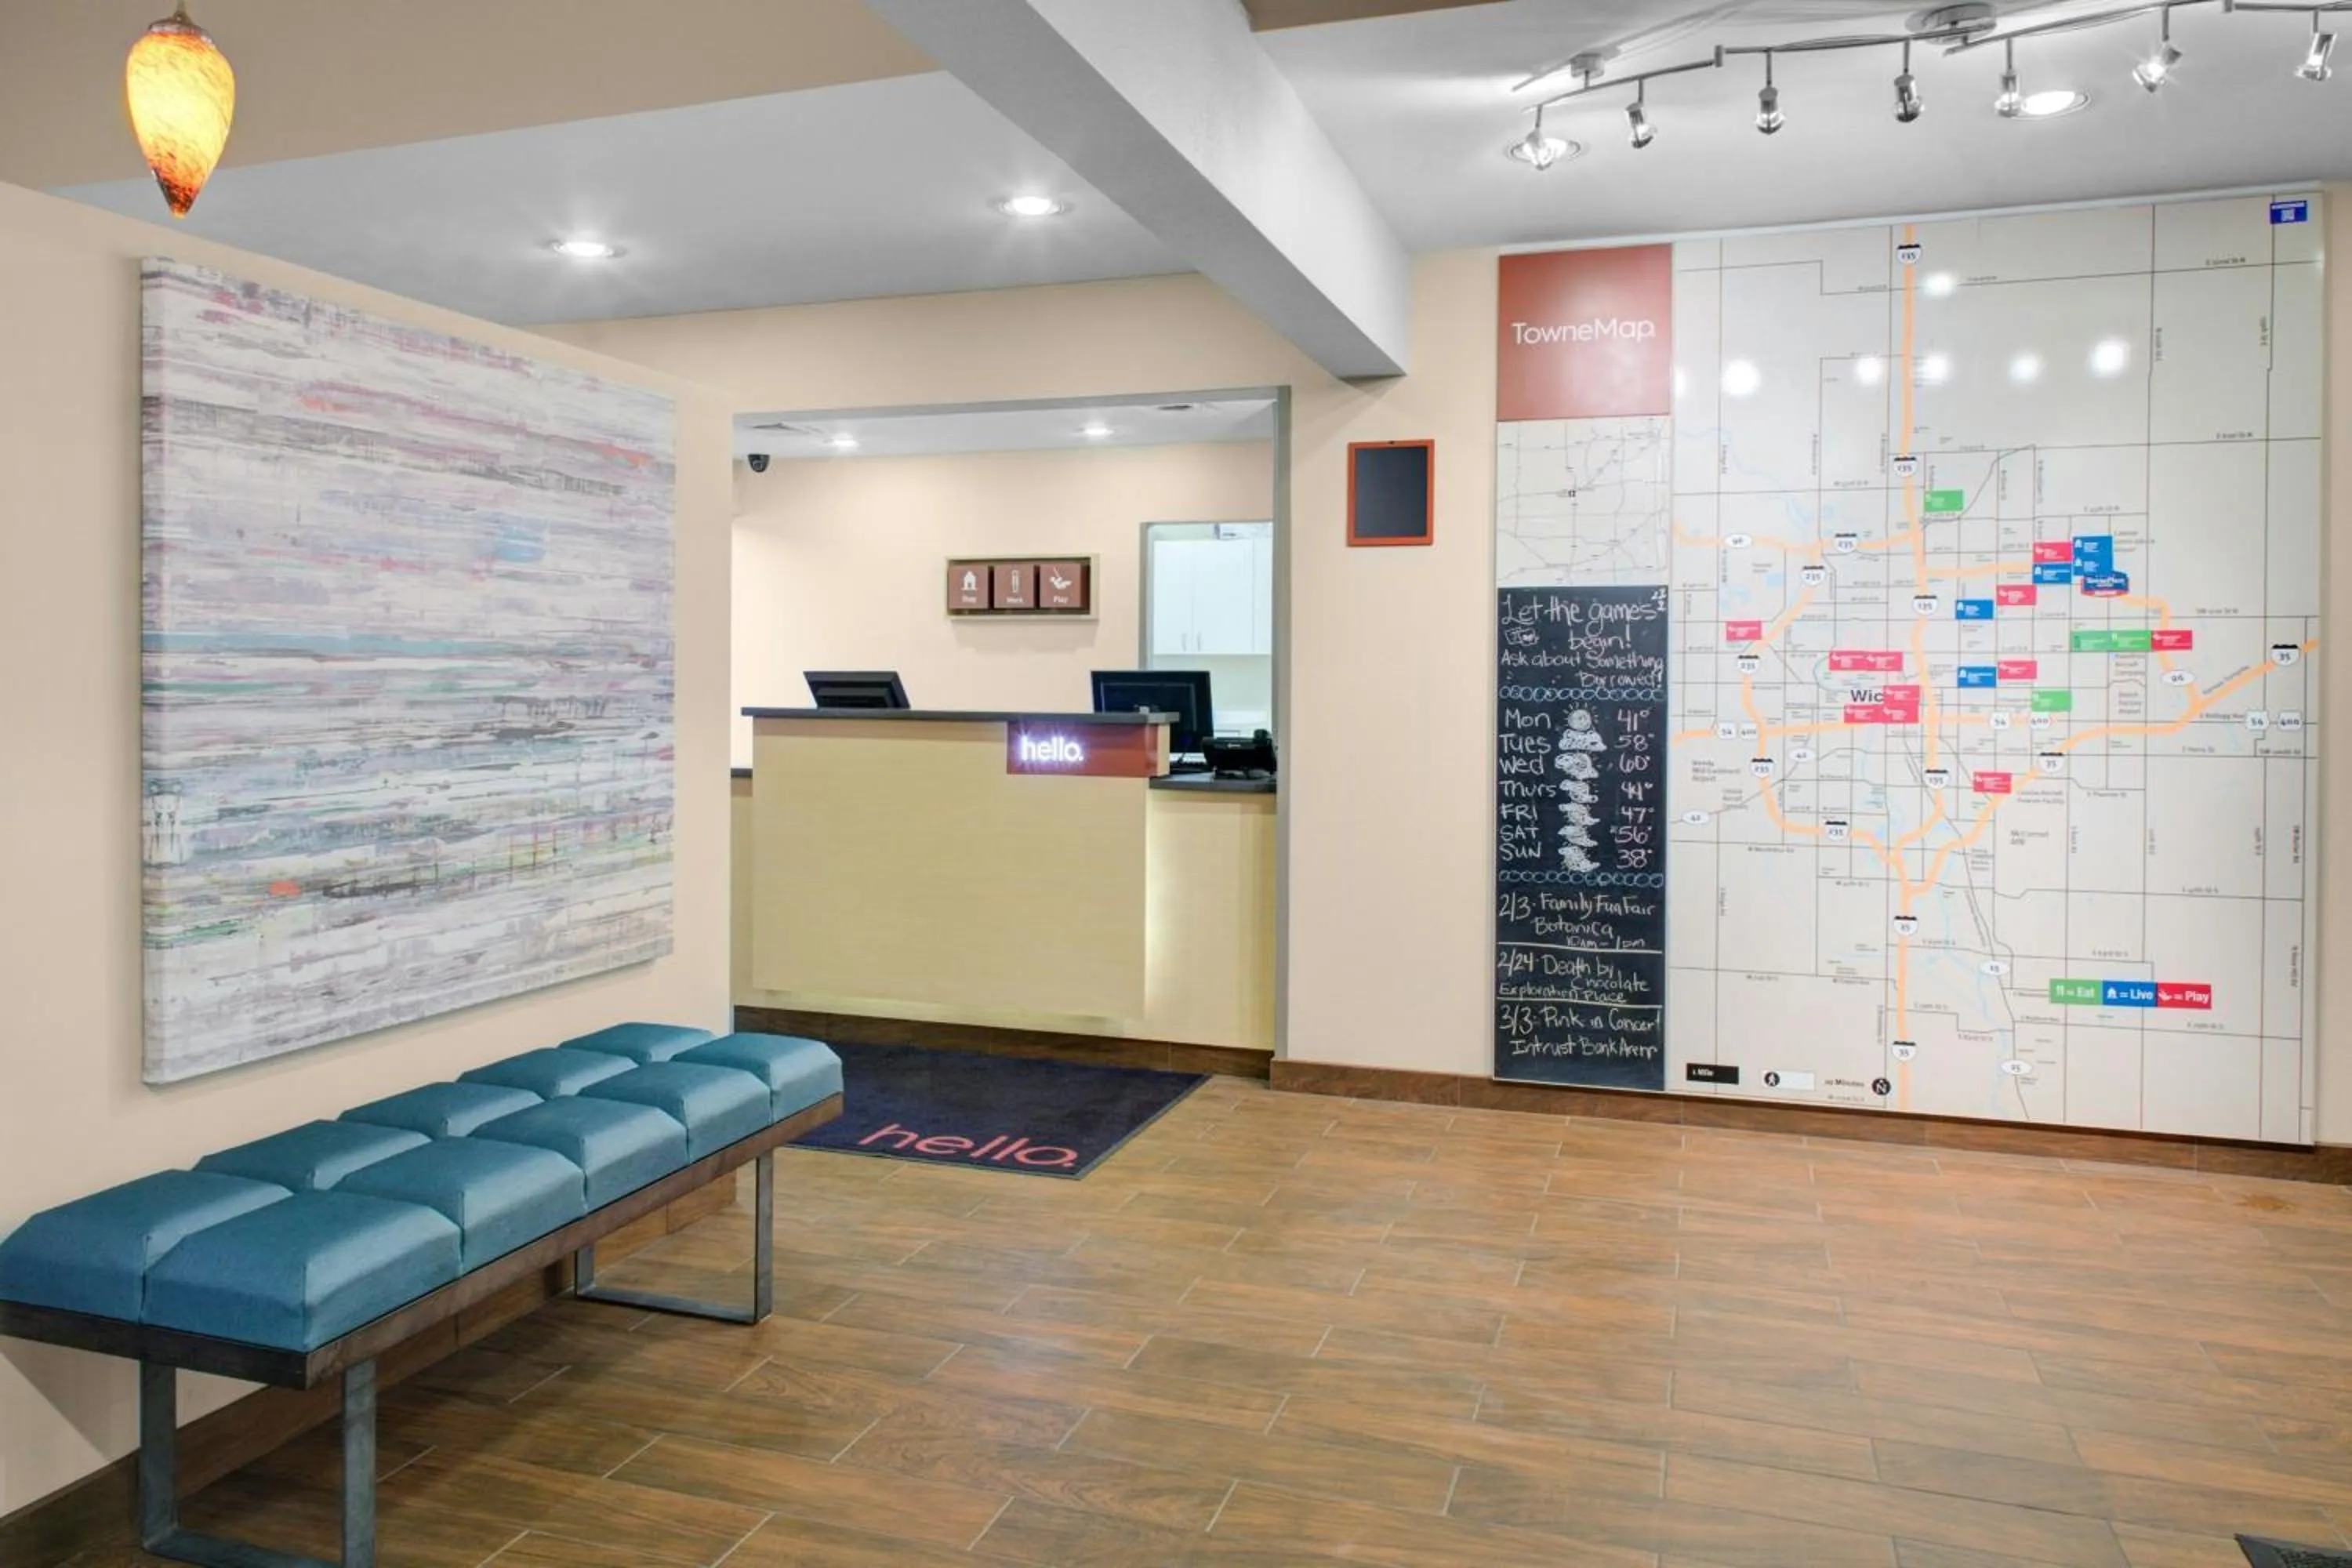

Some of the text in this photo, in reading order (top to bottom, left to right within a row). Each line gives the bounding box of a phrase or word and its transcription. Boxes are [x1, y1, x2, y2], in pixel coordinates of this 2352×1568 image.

[1512, 318, 1656, 345] TowneMap
[1501, 593, 1657, 637] Let the games
[1501, 649, 1528, 666] Ask
[1531, 649, 1581, 667] about
[1504, 708, 1552, 729] Mon
[1020, 735, 1083, 762] hello.
[1499, 732, 1552, 754] Tues
[1499, 753, 1544, 775] Wed
[1499, 779, 1557, 797] Thurs
[1500, 803, 1538, 822] FRI
[1500, 824, 1540, 842] SAT
[1499, 841, 1542, 861] SUN
[1540, 891, 1593, 920] Family
[1593, 895, 1623, 916] Fun
[1622, 895, 1656, 916] Fair
[1541, 953, 1592, 977] Death
[1596, 956, 1614, 979] by
[2077, 985, 2096, 998] Eat
[2130, 988, 2154, 1000] Live
[2185, 990, 2209, 1004] Play
[1539, 1005, 1584, 1029] Pink
[1591, 1015, 1603, 1029] in
[1609, 1007, 1661, 1032] Concert
[1509, 1034, 1577, 1057] Intrust
[1578, 1036, 1617, 1056] Bank
[858, 1123, 1079, 1167] hello.
